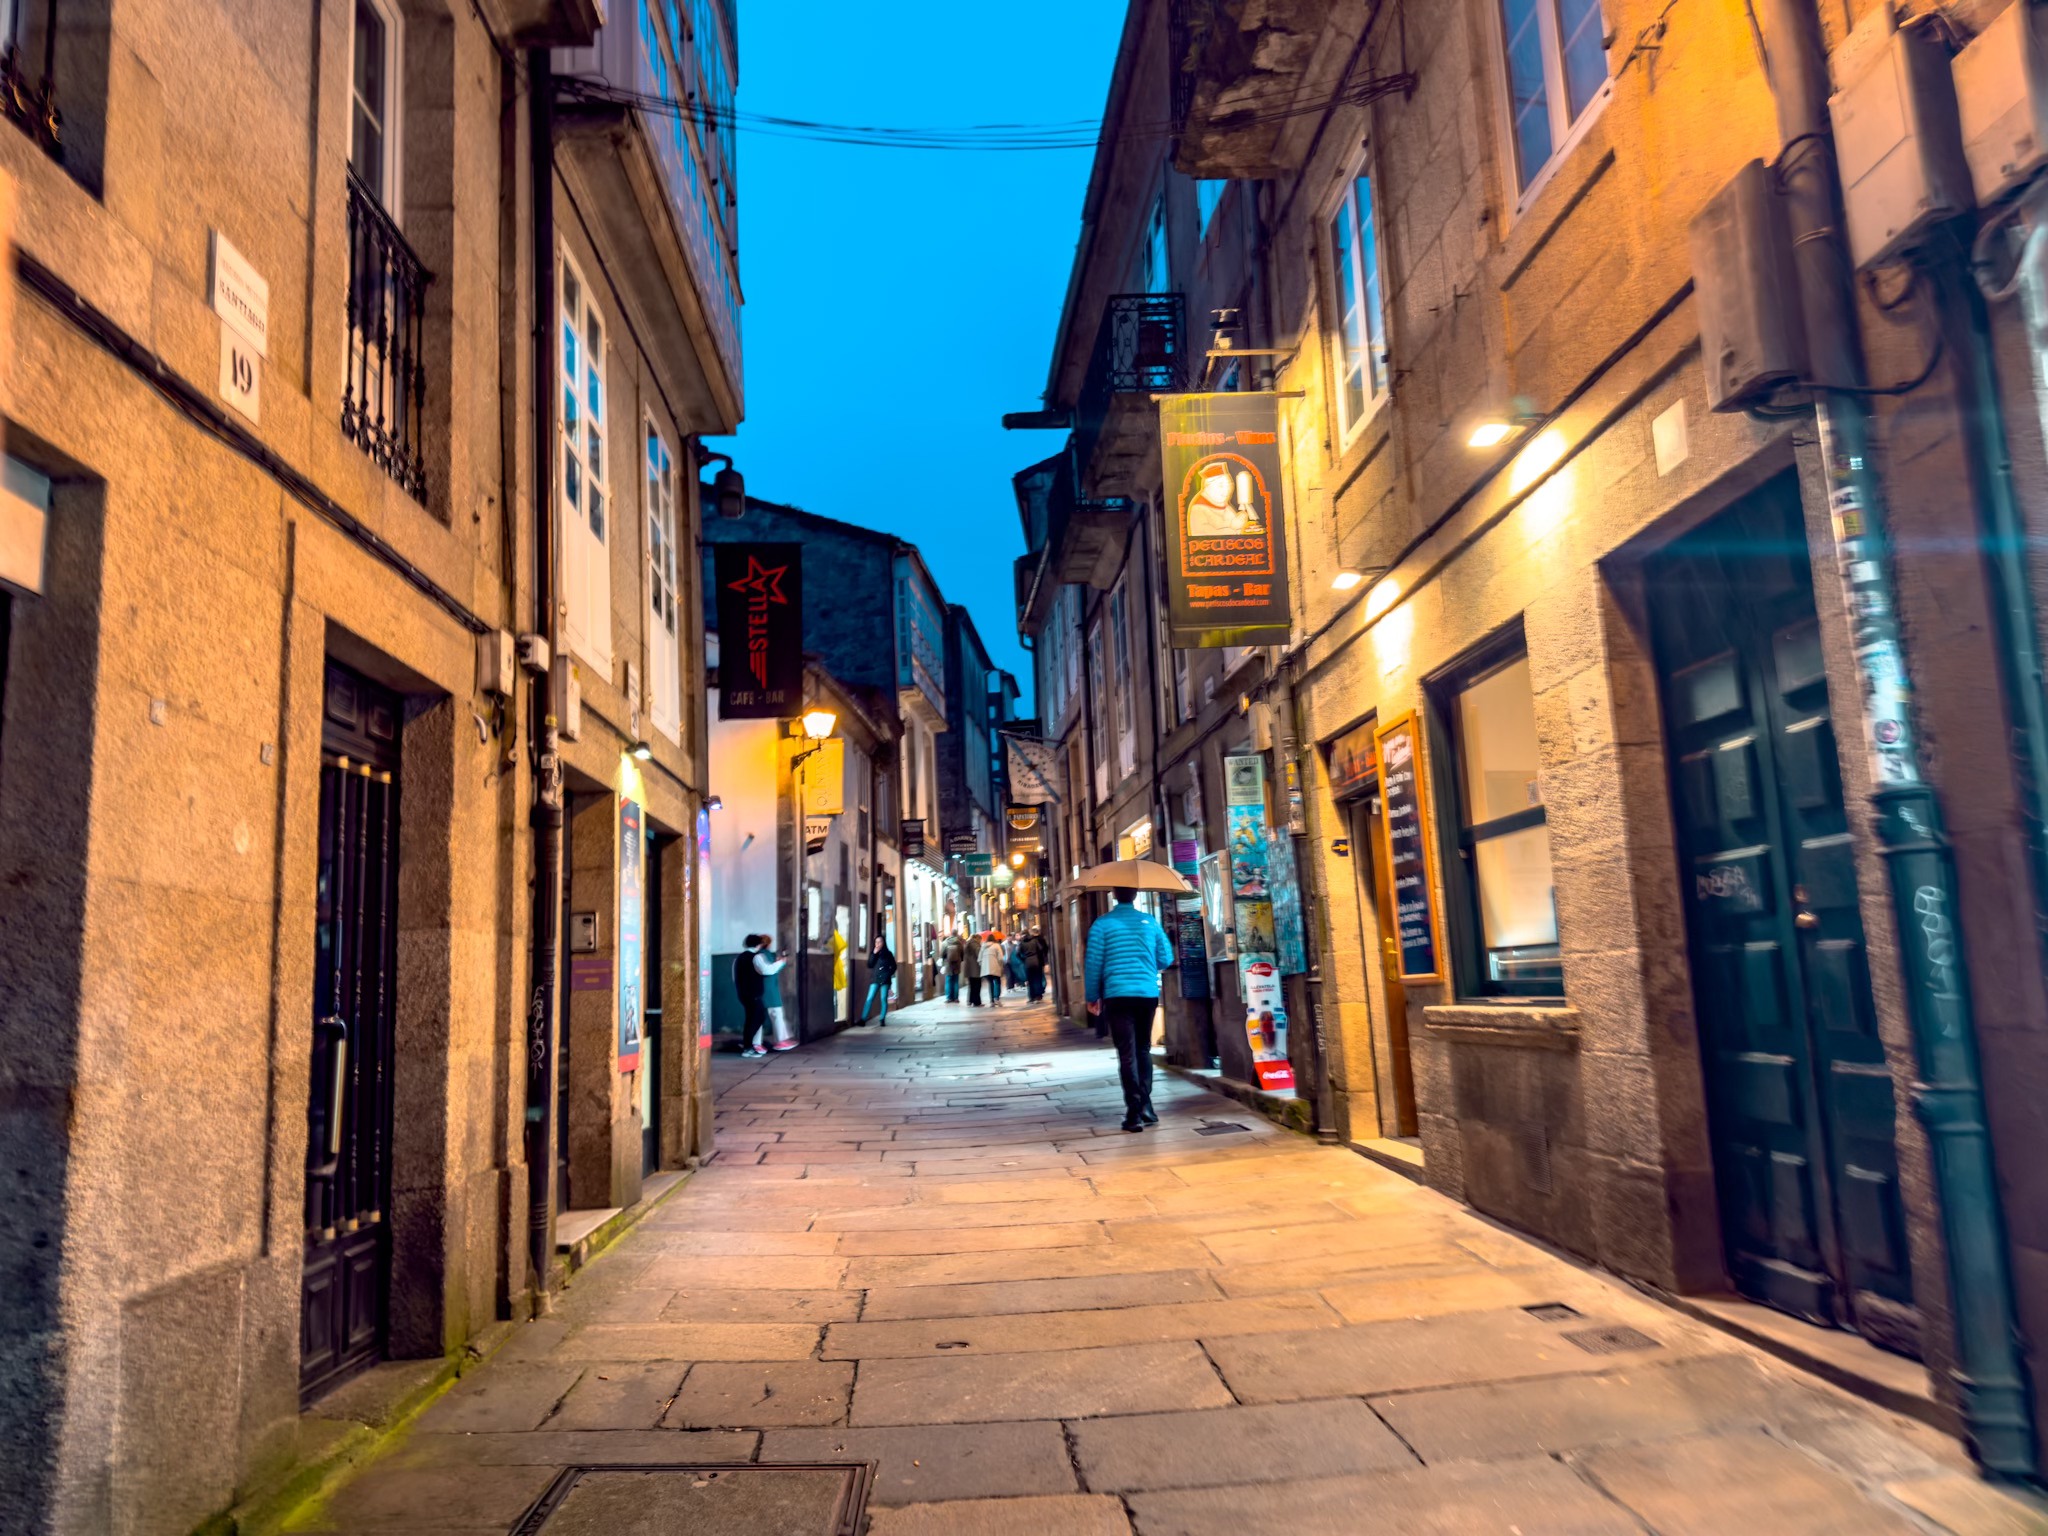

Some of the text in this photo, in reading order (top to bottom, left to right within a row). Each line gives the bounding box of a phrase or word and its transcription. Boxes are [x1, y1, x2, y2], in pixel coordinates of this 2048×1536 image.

[231, 346, 253, 394] 19
[1187, 583, 1231, 599] Tapas
[1243, 583, 1271, 597] Bar
[1229, 757, 1259, 766] WANTED
